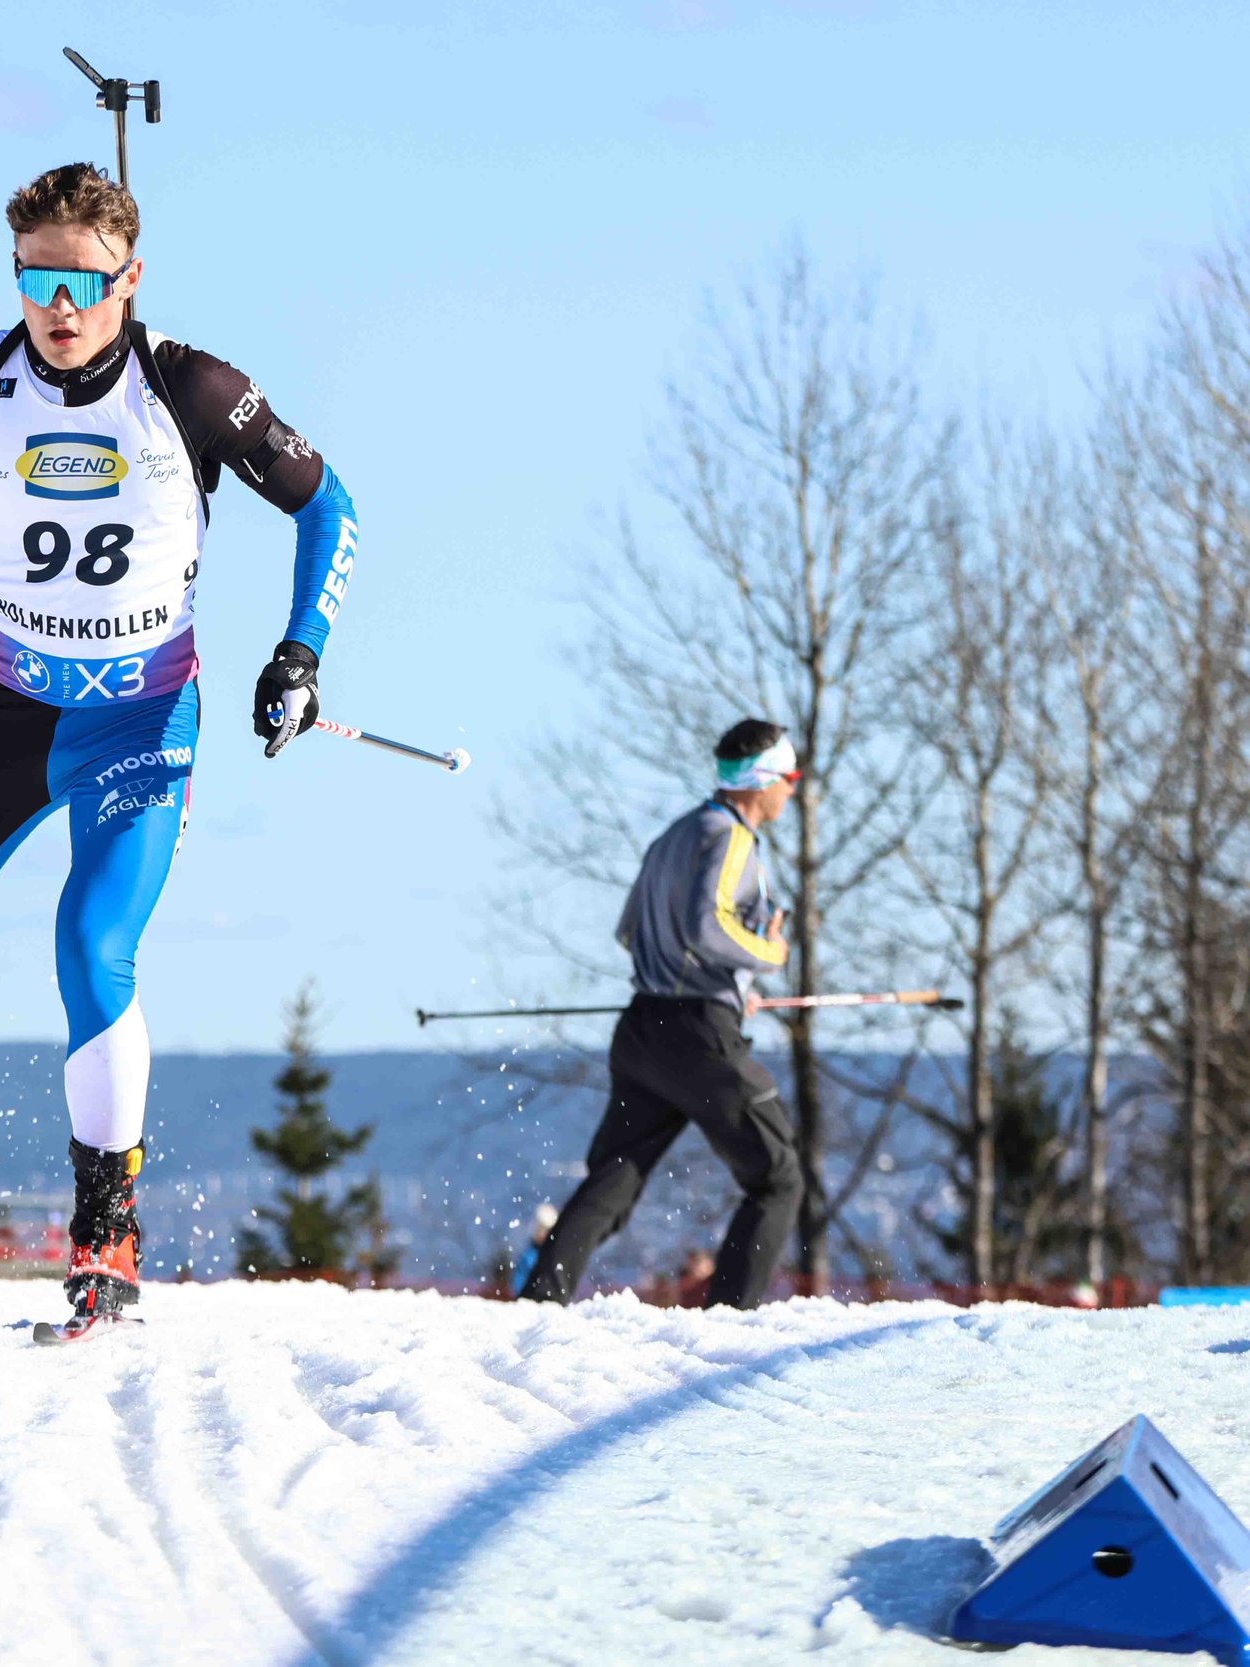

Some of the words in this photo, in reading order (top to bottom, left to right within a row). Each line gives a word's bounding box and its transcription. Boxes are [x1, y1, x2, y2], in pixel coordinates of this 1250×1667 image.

[28, 451, 117, 478] LEGEND
[136, 448, 175, 464] Servus
[144, 463, 180, 484] Tarjei
[22, 520, 135, 587] 98
[315, 516, 358, 627] EESTI
[62, 662, 70, 682] NEW
[73, 656, 145, 701] X3
[95, 746, 192, 786] moomoo
